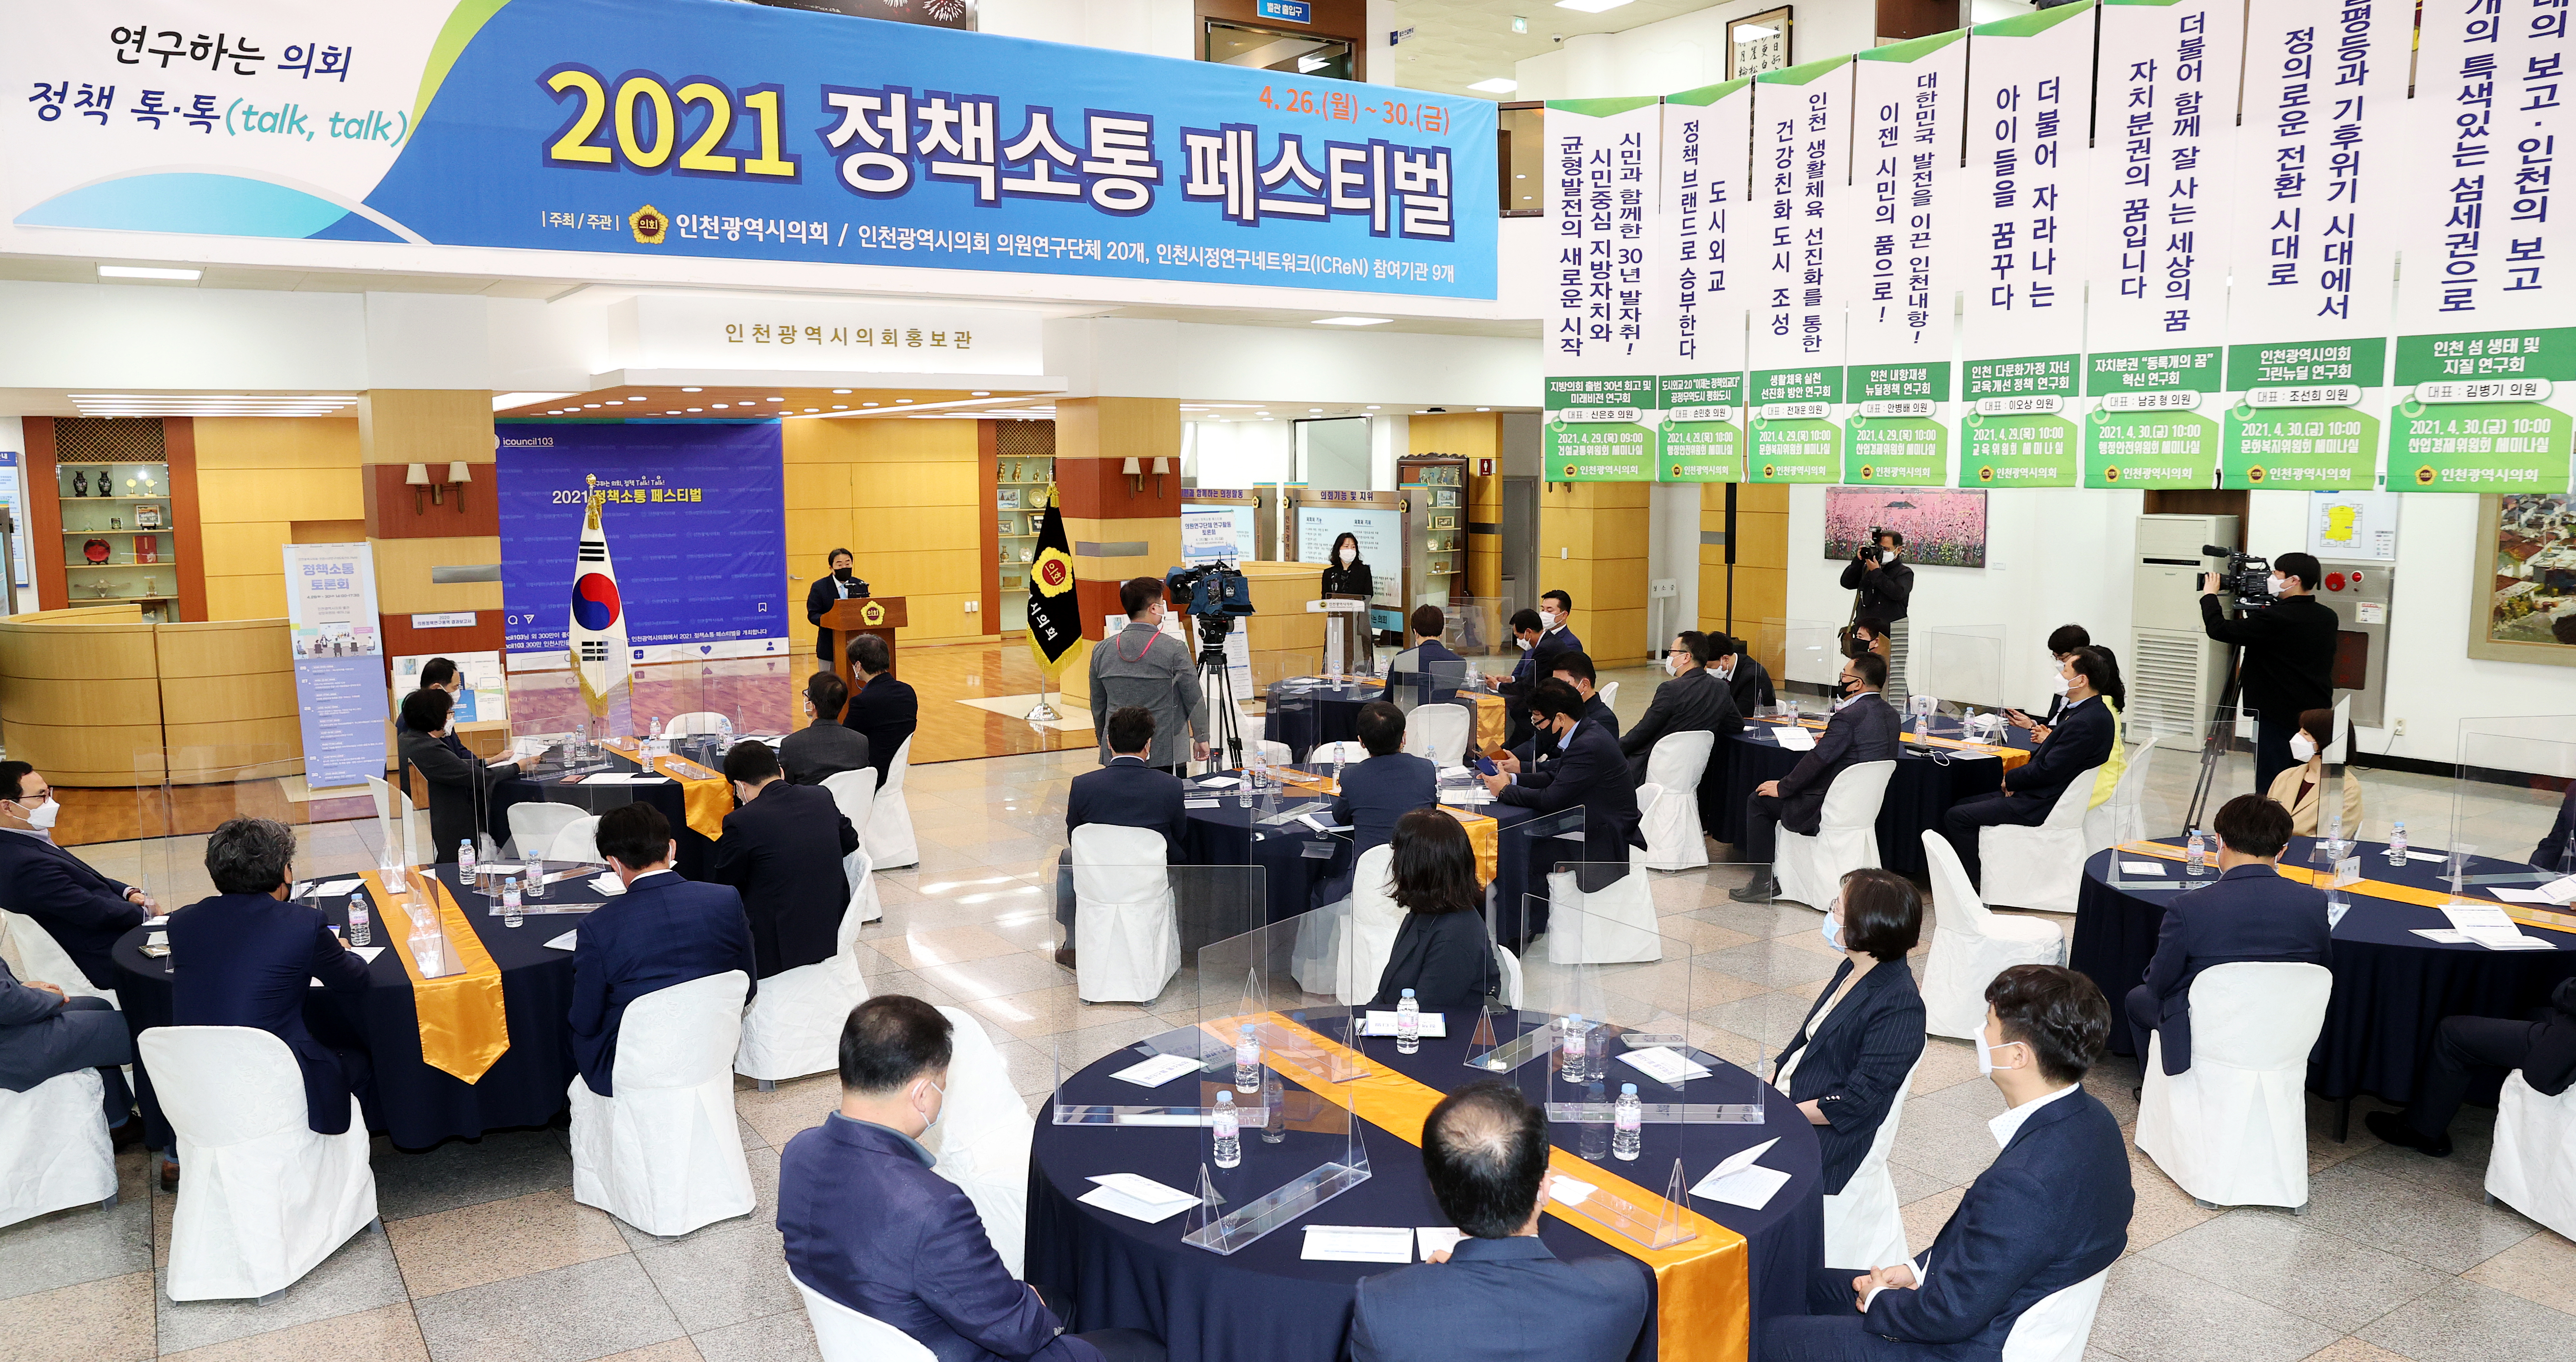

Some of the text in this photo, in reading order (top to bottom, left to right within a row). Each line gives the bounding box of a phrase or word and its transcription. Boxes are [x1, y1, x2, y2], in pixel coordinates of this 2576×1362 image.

[1267, 2, 1303, 17] 별관 출입구
[110, 25, 352, 82] 연구하는 의회
[28, 81, 115, 126] 정책
[330, 110, 407, 147] talk)
[1258, 85, 1450, 136] 4. 26.(월) 30.(금)
[2452, 53, 2498, 168] 특색있는
[546, 70, 1453, 237] 2021 정책소통 페스티벌
[2267, 26, 2315, 287] 정의로운 전환 시대로
[2317, 0, 2371, 319] 평등과 기후위기 시대에서
[2120, 58, 2158, 299] 자치분권의 꿈입니다
[2163, 11, 2206, 332] 더불어 함께 잘 사는 세상의 꿈
[1990, 85, 2020, 310] 아이들을 꿈꾸다
[2029, 76, 2061, 307] 더불어 자라나는
[1872, 102, 1899, 323] 이젠 시민의 품으로!
[1907, 72, 1938, 344] 대한민국 발전을 이끈 인천내항!
[639, 219, 658, 231] 의회
[1802, 92, 1827, 353] 인천 생활체육 선진화를 통한
[1590, 148, 1613, 342] 시민중심 지방자치와
[1618, 132, 1643, 356] 시민과 함께한 30년 발자취!
[1679, 120, 1700, 360] 정책브랜드로 승부한다
[1707, 180, 1727, 292] 도시외교
[2438, 174, 2486, 312] 섬세권으로
[676, 212, 828, 245] 인천광역시의회
[858, 225, 990, 255] 인천광역시의회
[996, 233, 1101, 262] 의원연구단체
[1106, 241, 1150, 265] 20개,
[1373, 258, 1428, 282] 참여기관
[1432, 263, 1455, 284] 9개
[1559, 136, 1583, 356] 균형발전의 새로운 시작
[2502, 236, 2546, 292] 보고
[1771, 288, 1790, 335] 조성
[2260, 346, 2352, 365] 인천광역시의회
[2434, 337, 2540, 357] 인천 섬 생태 및
[1972, 360, 2071, 378] 인천 다문화가정 자녀
[2095, 357, 2138, 372] 자치분권
[2257, 363, 2352, 381] 그린뉴딜 연구회
[2443, 356, 2526, 374] 지질 연구회
[1770, 372, 1821, 386] 생활체육 실천
[1870, 368, 1927, 382] 인천 내항재생
[2122, 371, 2180, 387] 혁신 연구회
[1550, 380, 1651, 392] 지방의회 출범 30년 회고 및
[1662, 380, 1683, 391] 도시외교
[1761, 385, 1831, 399] 선진화 방안 연구회
[1865, 382, 1931, 395] 뉴딜정책 연구회
[1971, 376, 2070, 393] 교육개선 정책 연구회
[2466, 383, 2537, 397] 김병기 의원
[1571, 393, 1631, 404] 미래비전 연구회
[1671, 390, 1731, 403] 공정무역도시 평화도시
[1591, 410, 1633, 419] 신은호 의원
[503, 437, 554, 445] icouncil103
[553, 488, 702, 504] 2021 정책소통 페스티벌
[1196, 490, 1218, 498] 함께하는
[1220, 490, 1243, 498] 의정활동
[1321, 491, 1373, 501] 의회기능 및 지위
[303, 563, 355, 576] 정책소통
[1045, 562, 1064, 585] 의회
[311, 578, 350, 591] 토론회
[867, 609, 879, 617] 의회
[1378, 615, 1387, 624] 의회
